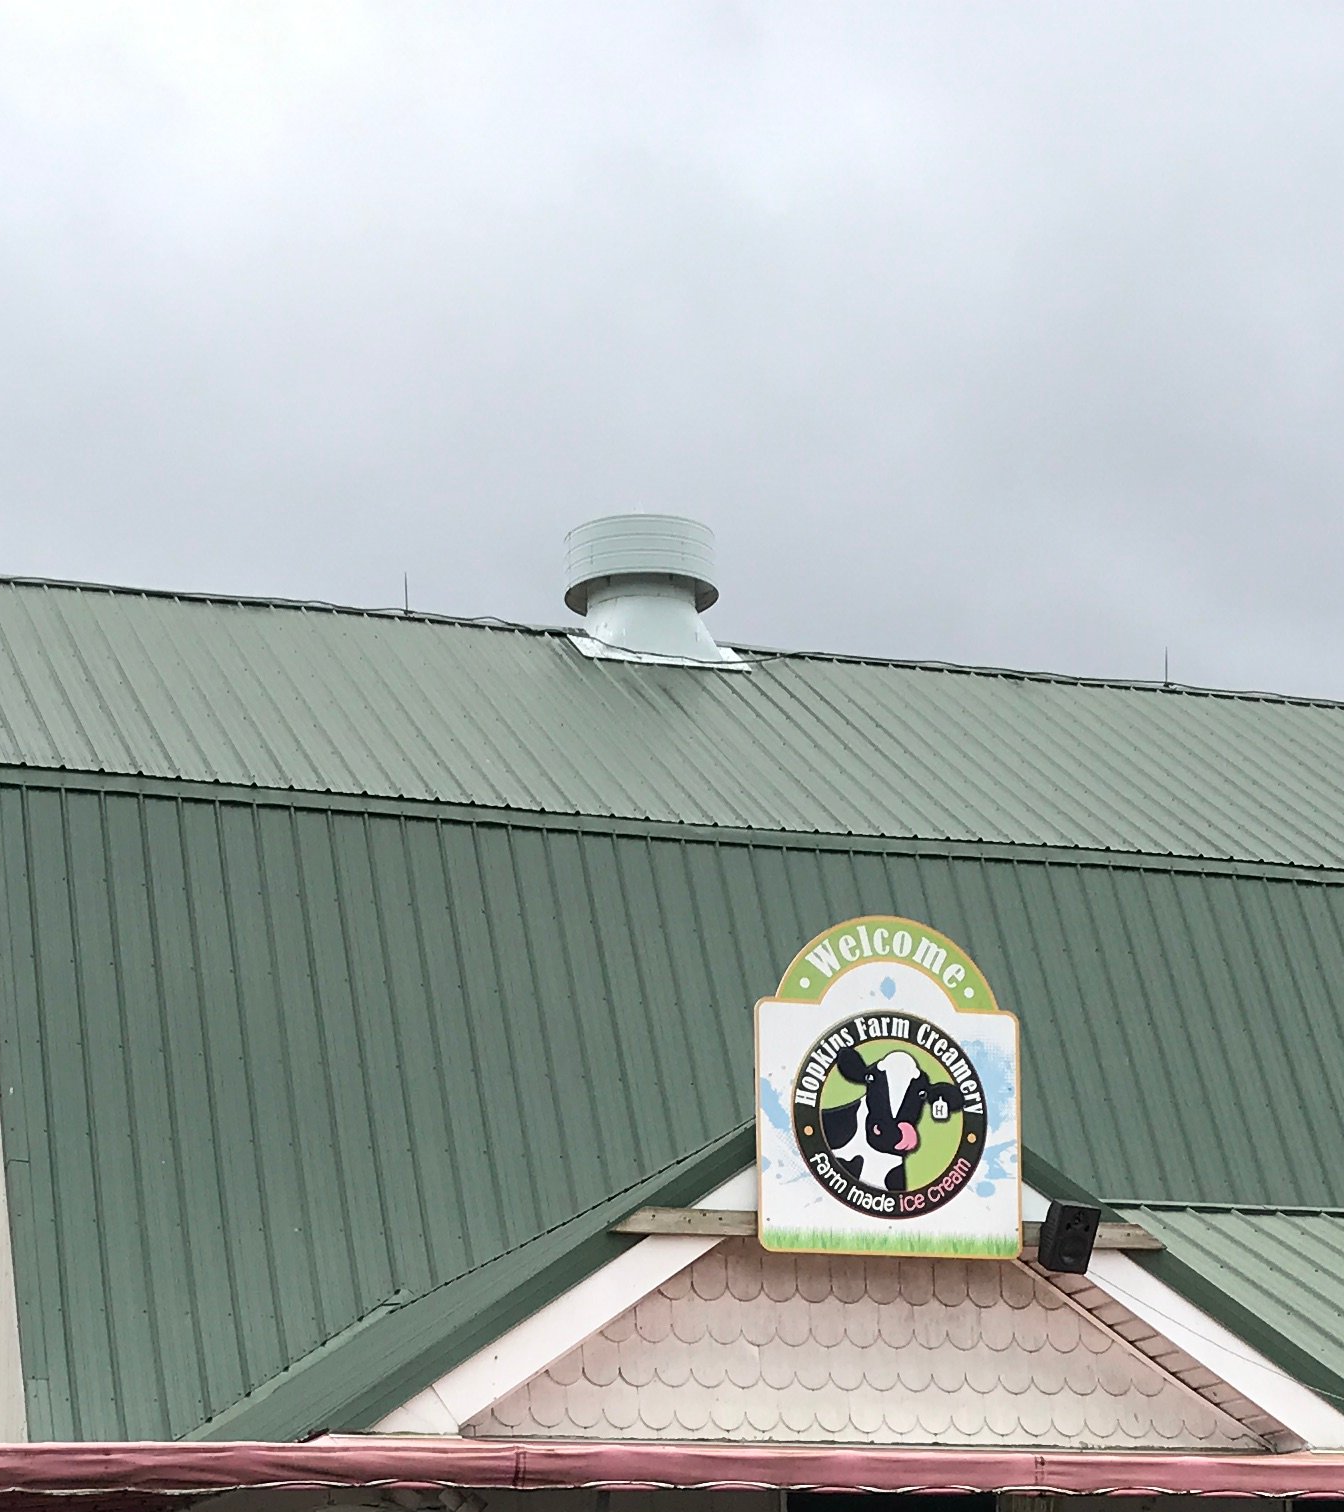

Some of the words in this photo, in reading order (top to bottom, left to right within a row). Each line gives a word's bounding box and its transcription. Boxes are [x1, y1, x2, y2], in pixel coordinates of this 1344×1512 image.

[805, 925, 966, 990] Welcome
[794, 1026, 856, 1108] Hopkins
[854, 1016, 909, 1040] Farm
[916, 1026, 985, 1115] Creamery
[847, 1183, 896, 1213] made
[899, 1192, 925, 1213] ice
[927, 1157, 971, 1204] cream
